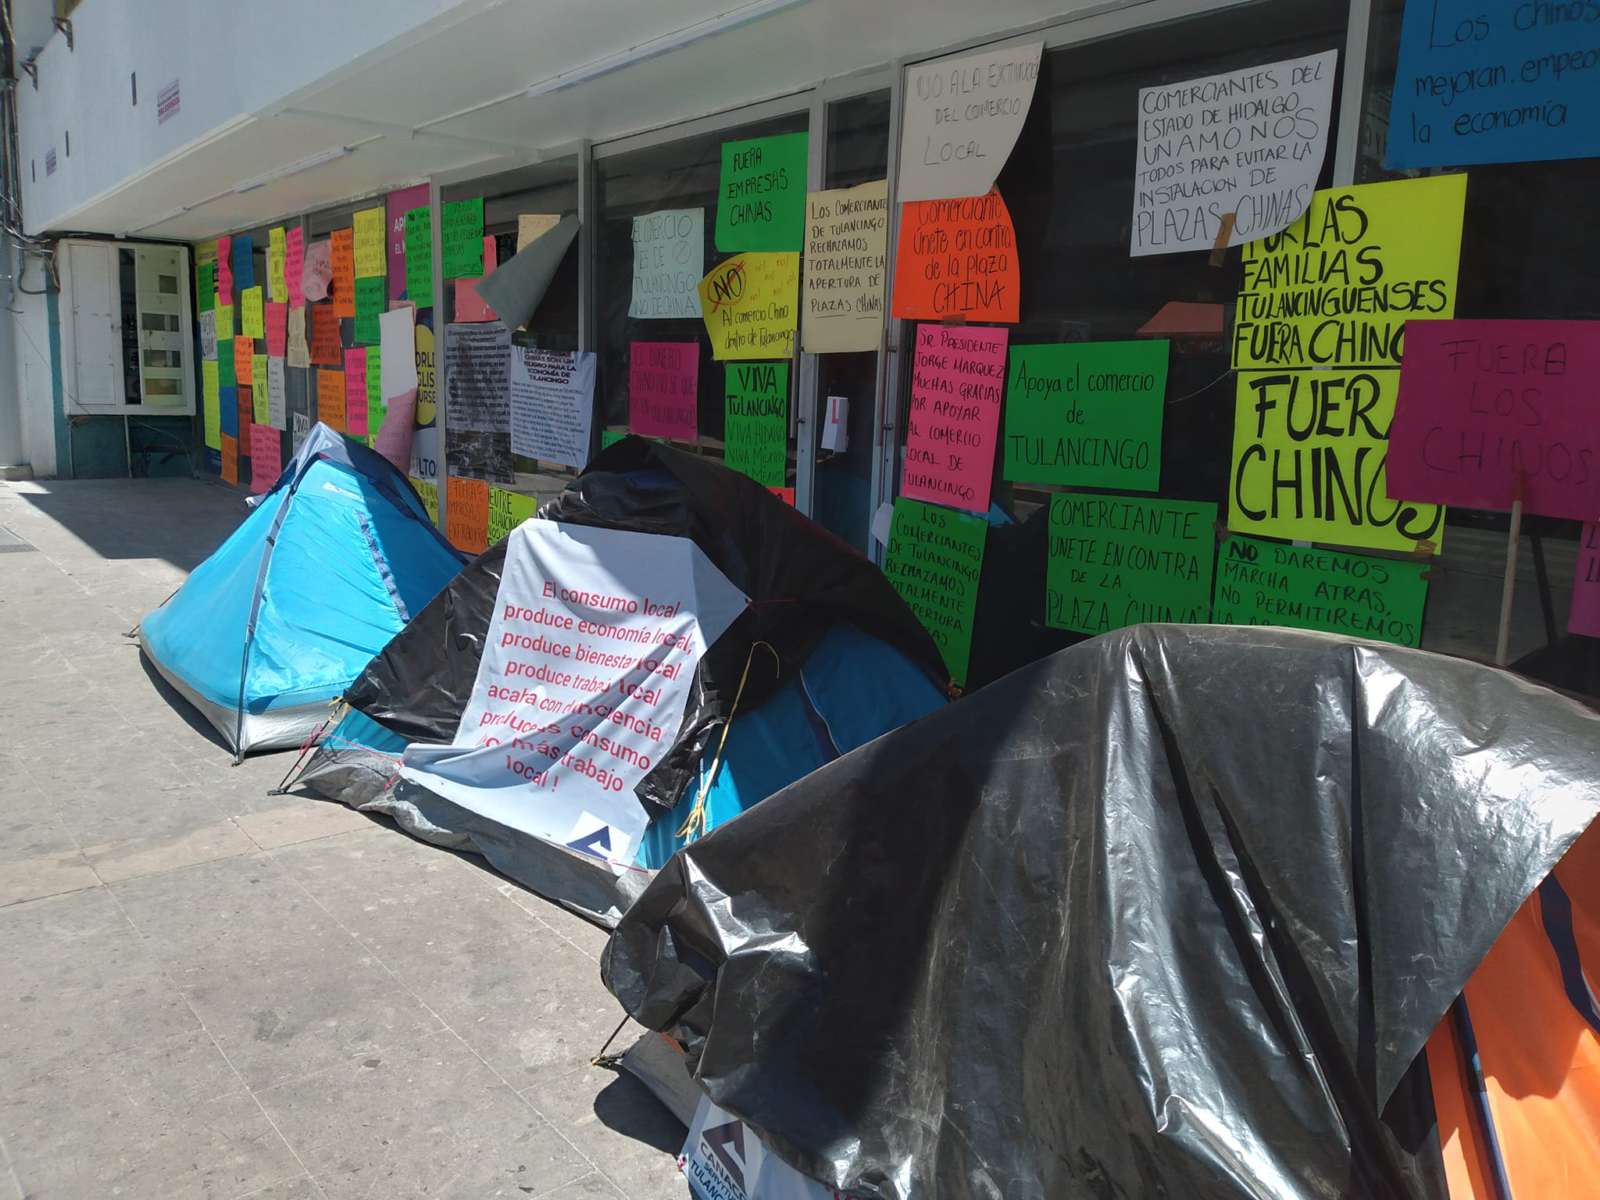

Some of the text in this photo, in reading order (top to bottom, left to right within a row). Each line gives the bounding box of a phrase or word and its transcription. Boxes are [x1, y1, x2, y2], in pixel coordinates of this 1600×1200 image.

[1520, 47, 1600, 83] empeo
[1142, 61, 1323, 114] COMERCIANTES DEL
[1201, 109, 1222, 126] DE
[1228, 91, 1300, 124] HIDALGO
[1411, 111, 1432, 144] la
[732, 146, 762, 172] FUERA
[923, 136, 987, 166] LOCAL
[1138, 141, 1313, 186] TODOS PARA EVITAR LA
[727, 167, 789, 199] EMPRESAS
[1138, 166, 1279, 208] INSTALACION DE
[729, 200, 773, 227] CHINAS
[811, 198, 888, 220] LOS COMERCIANTE
[1137, 183, 1309, 248] PLAZAS CHINAS
[1303, 194, 1369, 250] LAS
[812, 217, 885, 239] DE TULANCINGO
[809, 237, 868, 255] RECHAZAMOS
[808, 255, 885, 271] TOTALMENTE LA
[924, 257, 941, 281] de
[947, 253, 960, 278] la
[1241, 245, 1384, 292] FAMILIAS
[712, 268, 742, 300] NO
[808, 272, 881, 290] APERTURA DE
[933, 279, 1006, 314] CHINA
[810, 298, 852, 313] PLAZAS
[1237, 279, 1448, 321] TULANCINGUENSES
[1233, 320, 1304, 367] FUERA
[1439, 338, 1567, 376] FUERA
[737, 366, 778, 394] VIVA
[915, 351, 1004, 380] JORGE MARQUEZ
[1015, 359, 1155, 401] Apoya el comercio
[913, 372, 1001, 404] MUCHAS GRACIAS
[1470, 380, 1544, 428] LOS
[726, 394, 785, 418] TULANCINGO
[933, 401, 982, 422] APOYAR
[1065, 399, 1086, 425] de
[1249, 374, 1392, 442] FUER
[928, 423, 981, 448] COMERCIO
[950, 454, 963, 472] DE
[1008, 435, 1150, 470] TULANCINGO
[1421, 426, 1594, 486] CHINOS
[922, 507, 946, 529] LOS
[1050, 499, 1201, 540] COMERCIANTE
[896, 513, 982, 562] COMERCIANTES
[911, 543, 979, 582] TULANCINGO
[1050, 535, 1199, 582] UNETE EN CONTRA
[1227, 540, 1390, 585] NO DAREMOS
[1071, 568, 1121, 590] DE LA
[1224, 562, 1289, 594] MARCHA
[542, 581, 681, 619] El consumo local
[1047, 589, 1111, 632] PLAZA
[1221, 585, 1416, 647] NO PERMITIREMOS
[503, 604, 573, 631] produce
[577, 619, 652, 645] economía
[911, 602, 964, 633] PERTURA
[501, 631, 571, 659] produce
[504, 660, 571, 688] produce
[539, 698, 567, 714] con
[506, 754, 549, 788] local
[560, 750, 624, 793] trabajo
